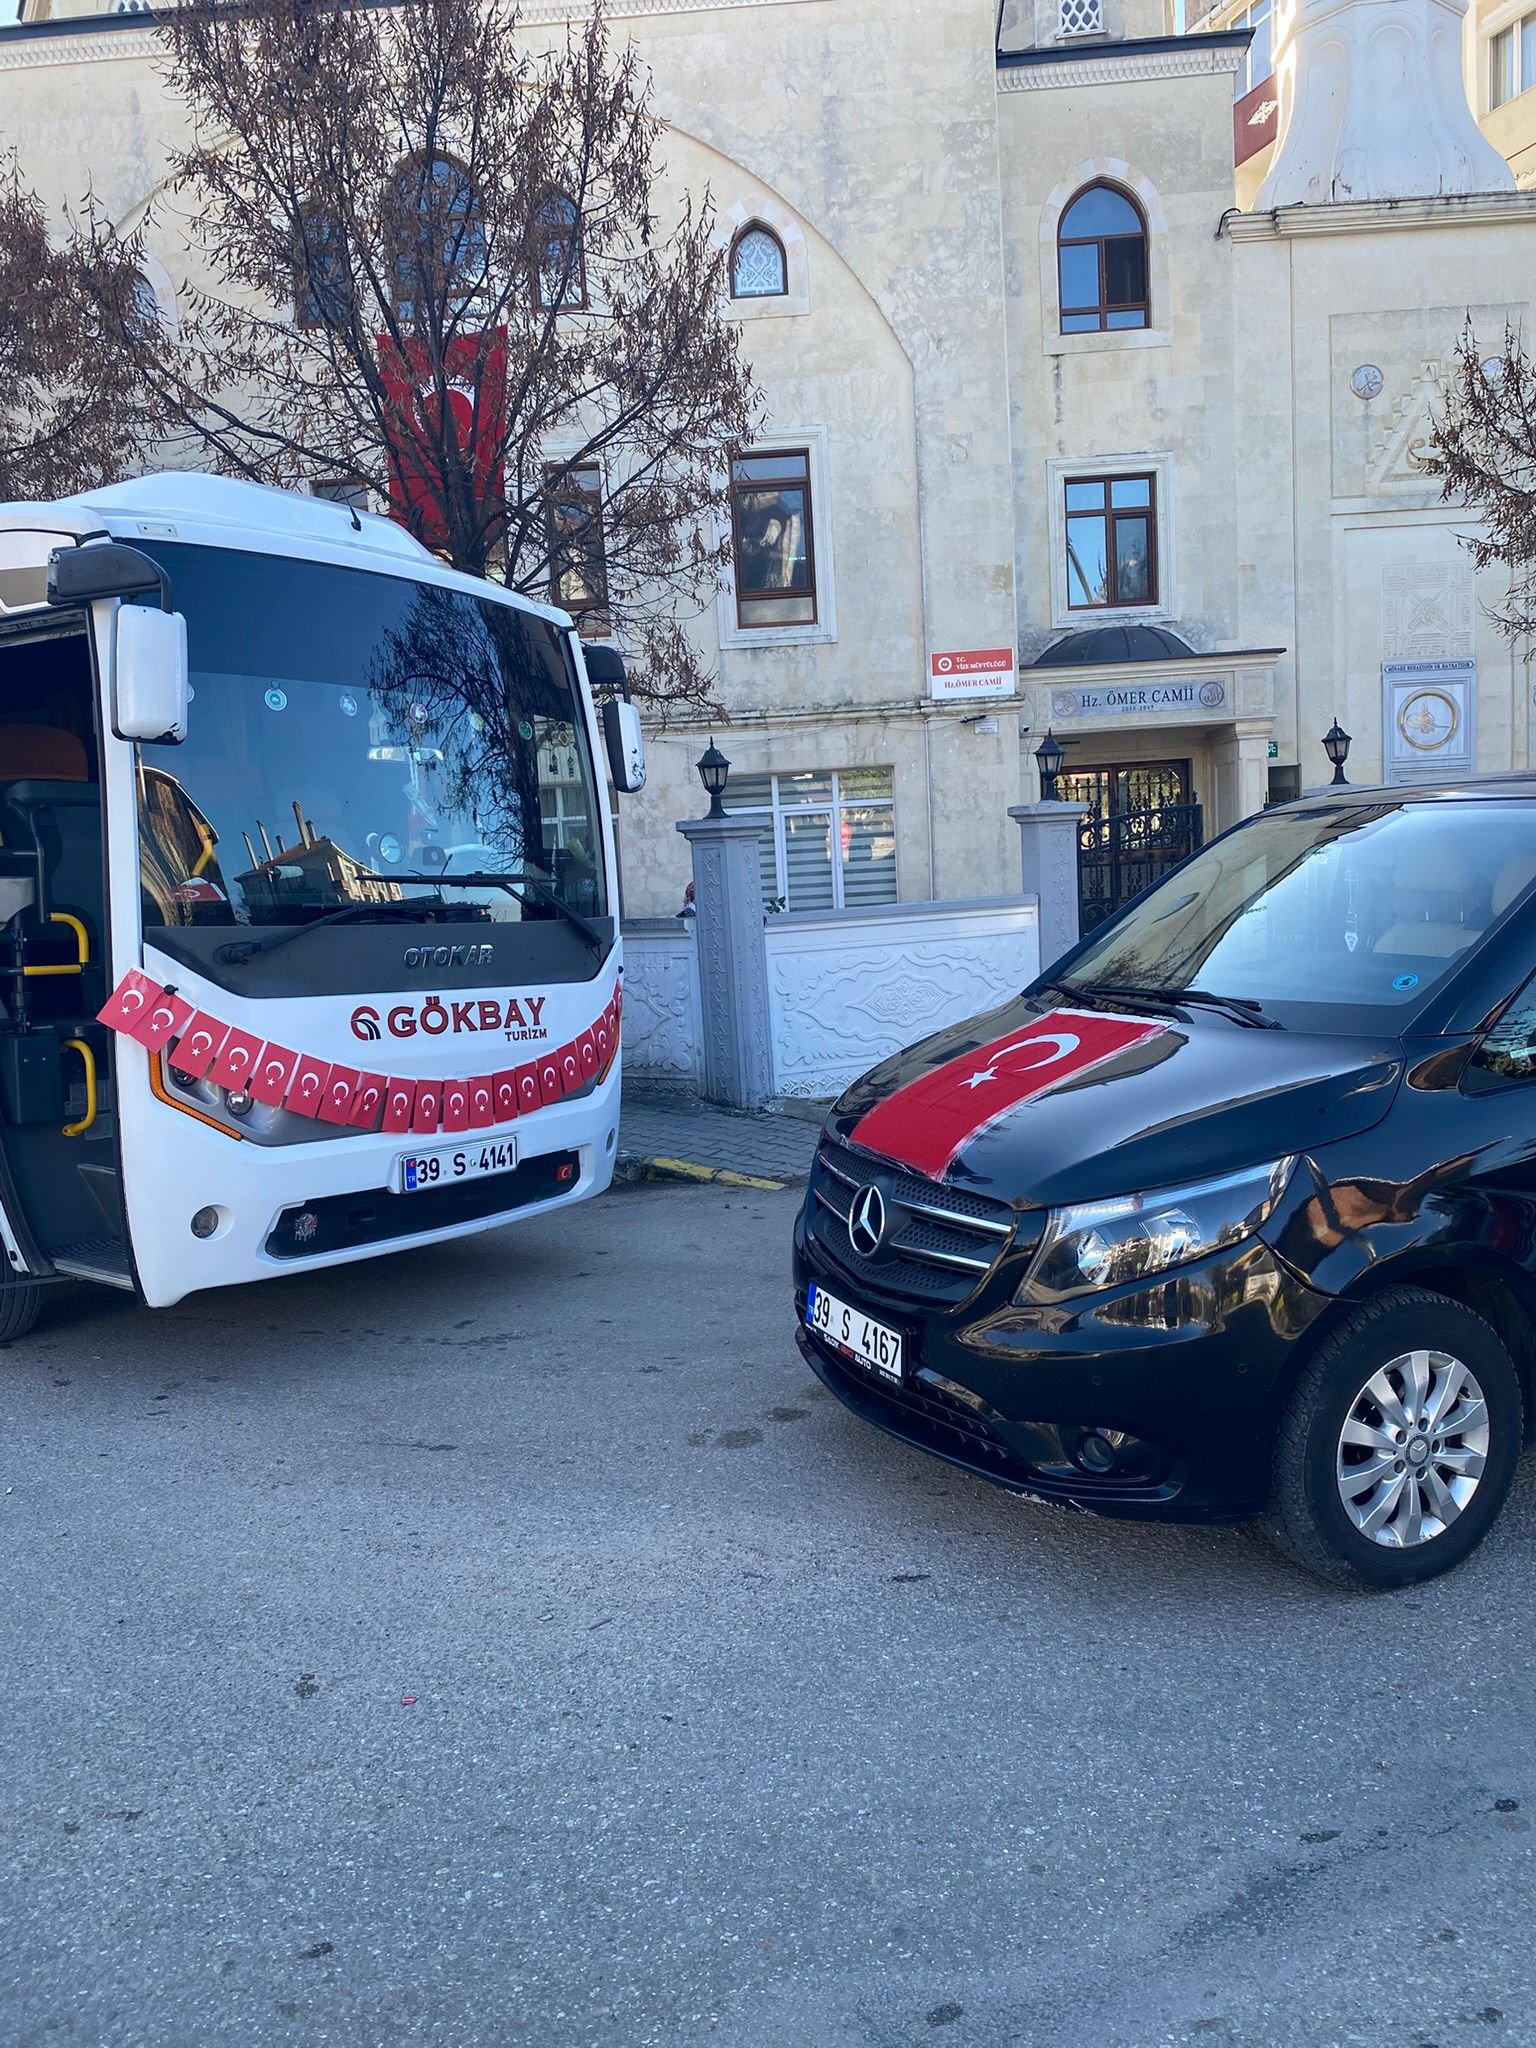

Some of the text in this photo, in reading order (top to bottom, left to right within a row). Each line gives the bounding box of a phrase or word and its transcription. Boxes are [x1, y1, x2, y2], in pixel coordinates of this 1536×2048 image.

[979, 677, 1002, 686] CAMİİ
[1081, 695, 1102, 708] Hz.
[1106, 690, 1148, 706] ÖMER
[1151, 685, 1194, 703] CAMİİ
[403, 944, 494, 969] OTOKAR
[387, 995, 546, 1039] GÖKBAY
[504, 1028, 548, 1042] TURİZM
[417, 1143, 513, 1184] 39 S 4141
[814, 1291, 831, 1328] 39
[841, 1308, 851, 1342] S
[861, 1321, 900, 1369] 4167
